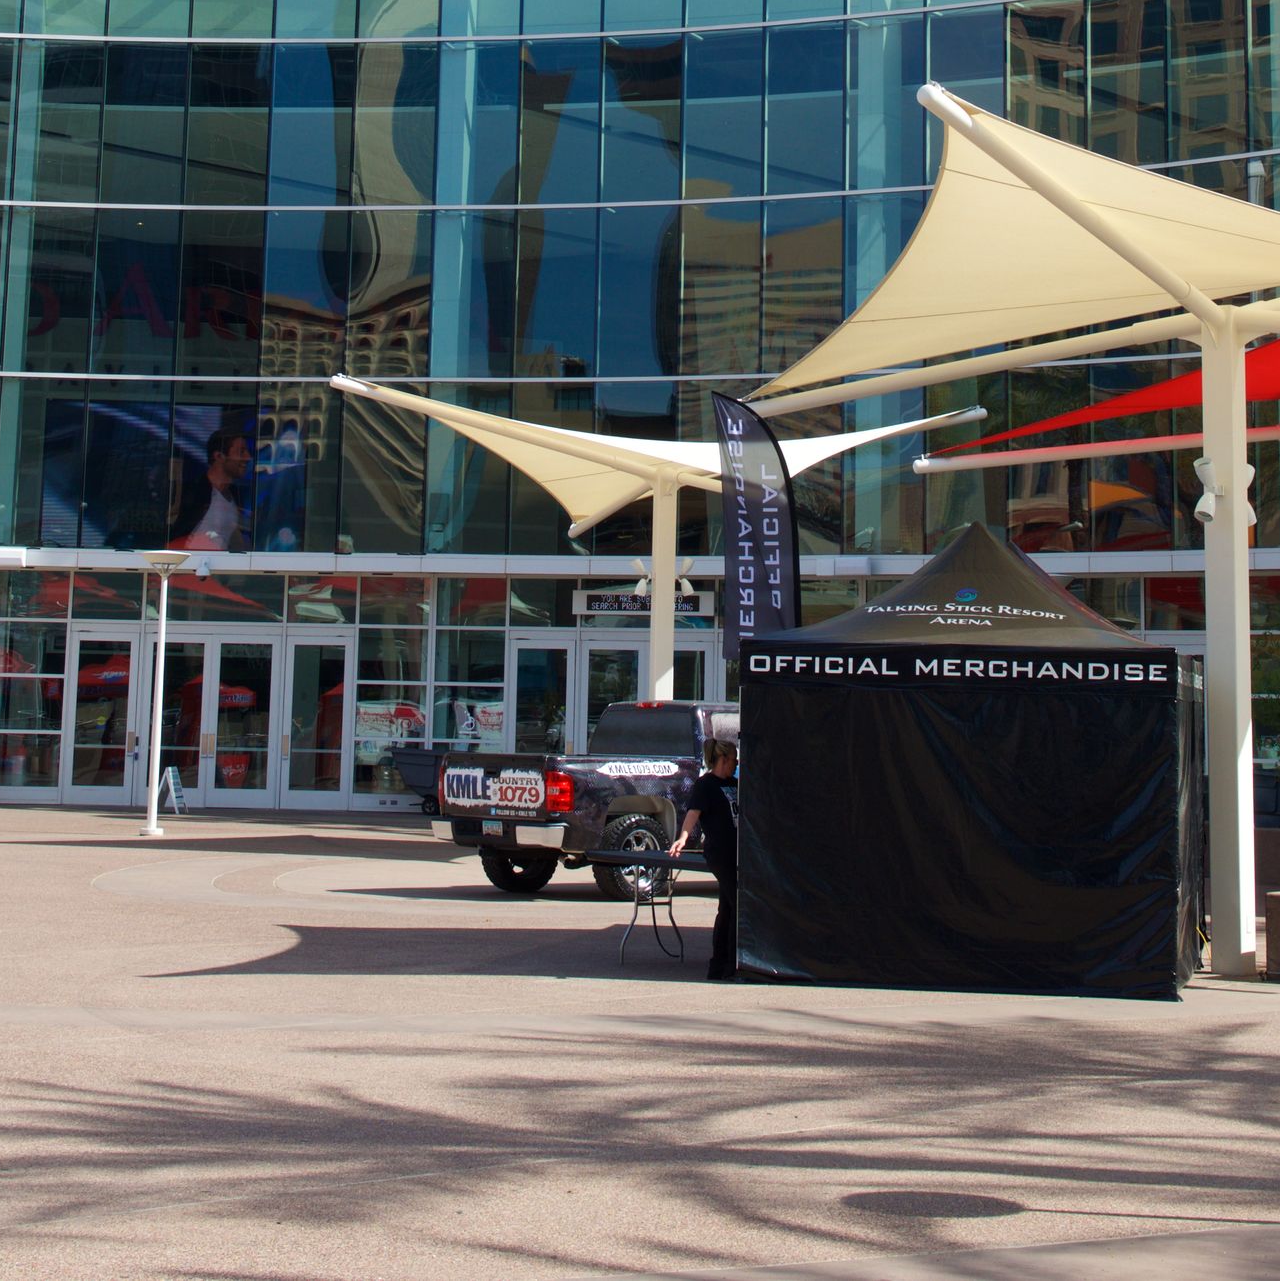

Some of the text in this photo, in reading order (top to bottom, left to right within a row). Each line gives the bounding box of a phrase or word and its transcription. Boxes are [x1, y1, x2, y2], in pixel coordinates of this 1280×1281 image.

[601, 594, 616, 603] YOU
[591, 602, 618, 610] SEARCH
[865, 603, 1067, 620] TALKING STICK RESORT
[929, 616, 993, 626] ARENA
[749, 654, 1169, 683] OFFICIAL MERCHANDISE
[608, 764, 672, 775] KMLE1079.COM
[446, 773, 540, 800] KMLE COUNTRY
